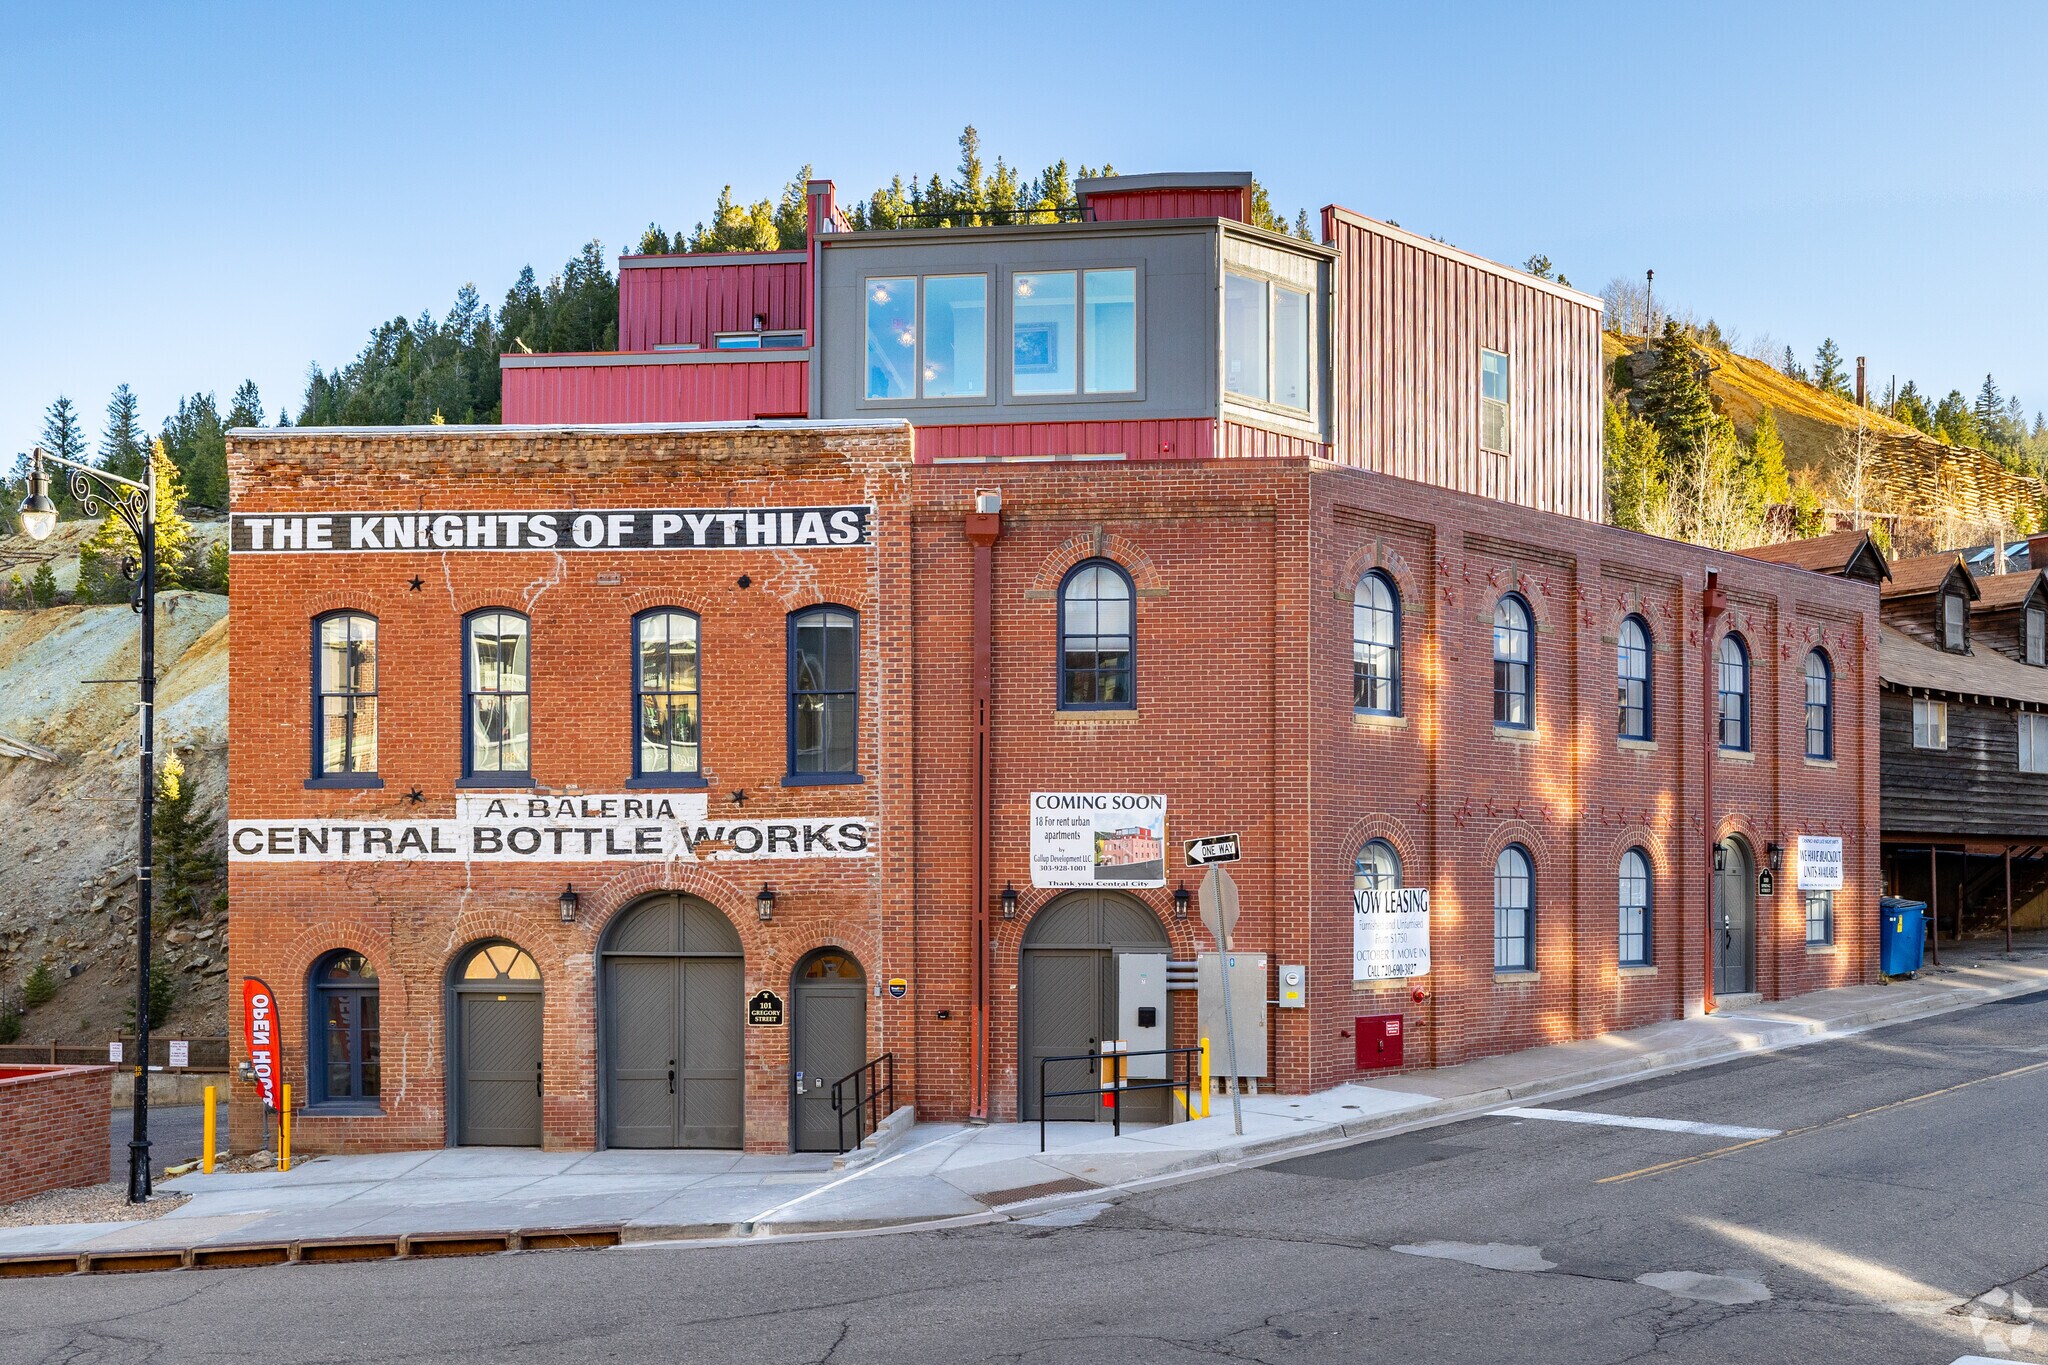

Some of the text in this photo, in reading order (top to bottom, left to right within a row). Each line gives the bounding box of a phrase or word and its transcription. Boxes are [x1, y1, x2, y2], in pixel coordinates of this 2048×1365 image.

[244, 510, 860, 549] THE KNIGHTS OF PYTHIAS
[1035, 795, 1162, 810] COMING SOON
[1035, 816, 1090, 826] 18 For rent urban
[232, 823, 868, 855] CENTRAL BOTTLE WORKS
[1044, 831, 1081, 843] apartments
[1202, 843, 1234, 857] ONE WAY
[1800, 850, 1841, 862] WE HAVE BLACKOUT
[1034, 854, 1049, 864] Gallup
[1050, 854, 1082, 864] Development
[1804, 866, 1838, 878] UNITS AVAILABLE
[1354, 889, 1428, 914] NOW LEASING
[1357, 950, 1389, 961] OCTOBER
[1397, 948, 1417, 959] MOVE
[1419, 947, 1427, 957] IN
[1368, 965, 1380, 977] CALL
